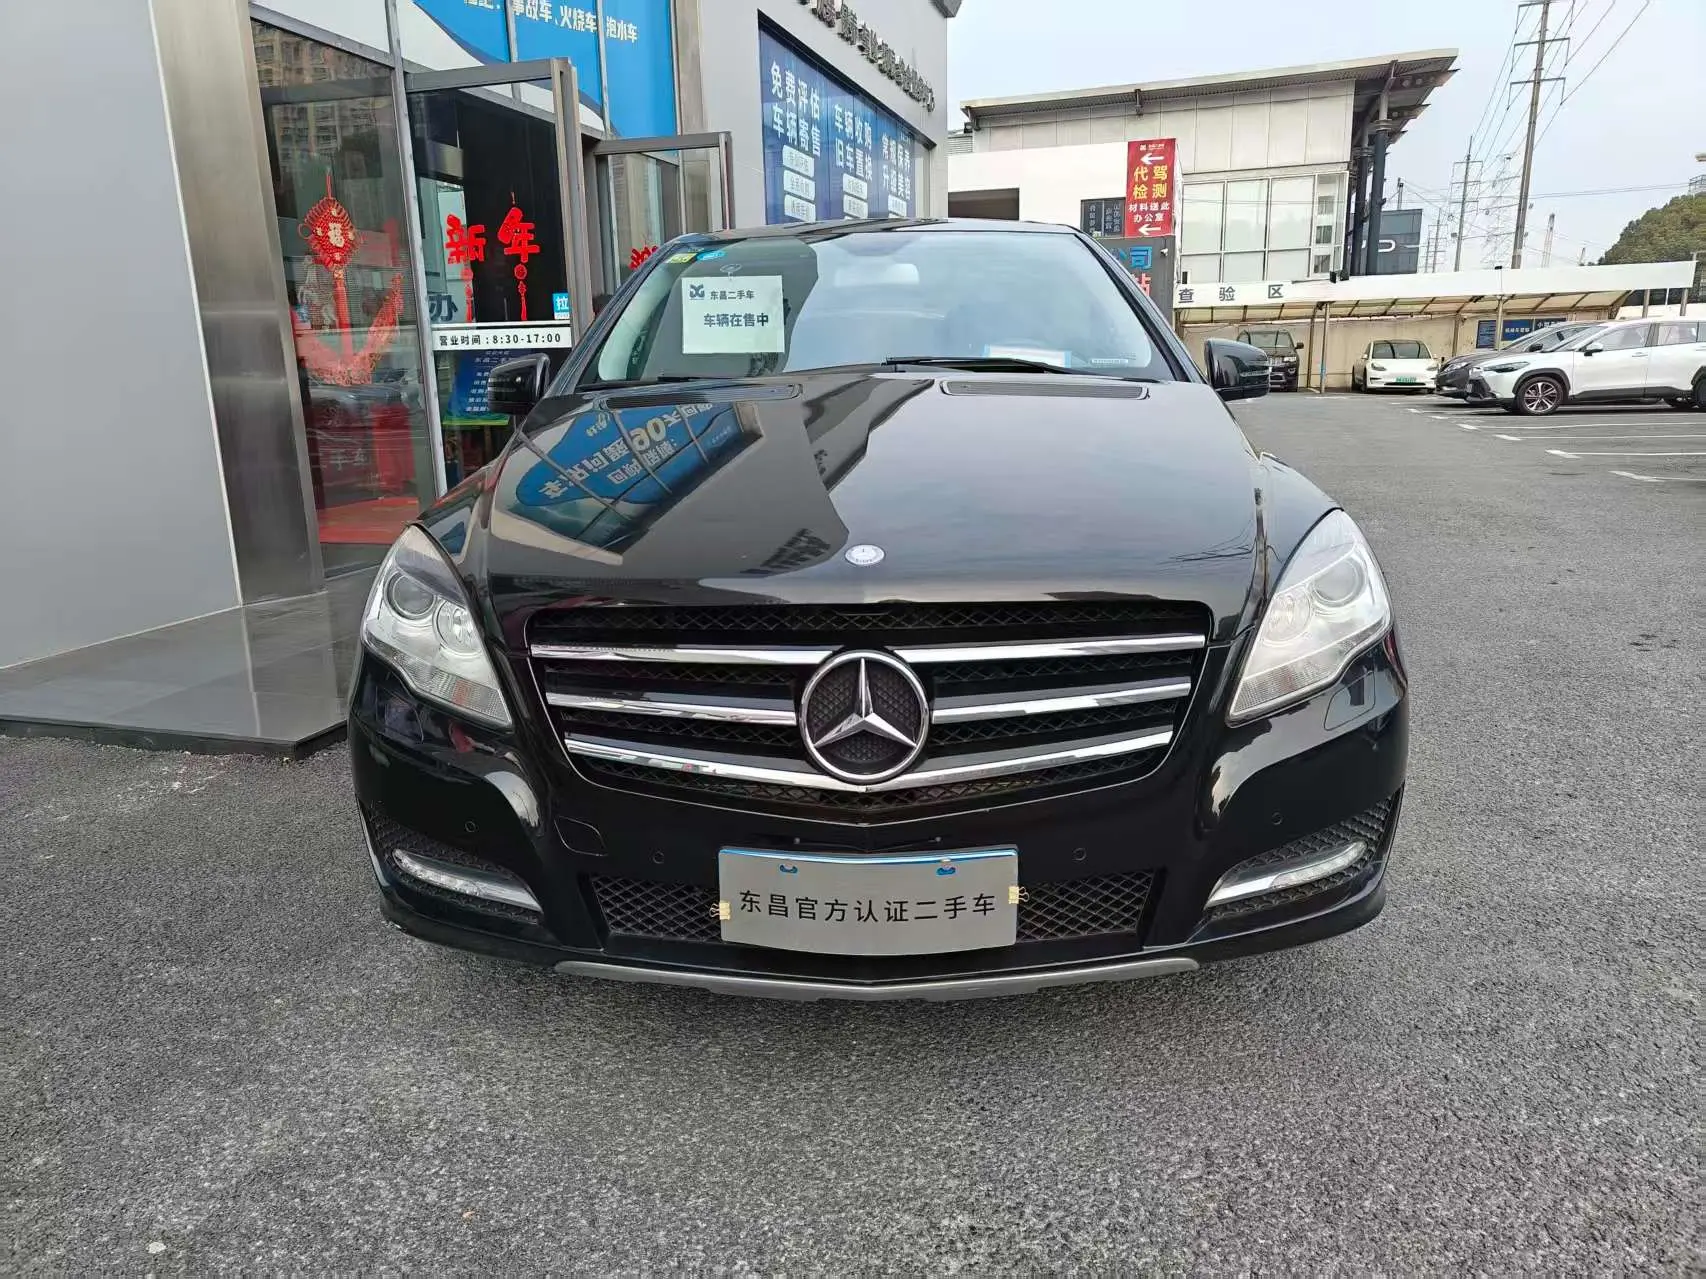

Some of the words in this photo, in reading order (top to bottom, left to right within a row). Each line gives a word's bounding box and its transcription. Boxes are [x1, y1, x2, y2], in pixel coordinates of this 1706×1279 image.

[771, 60, 820, 120] 免费评估
[772, 103, 820, 157] 车辆寄售
[834, 103, 871, 150] 车辆收购
[835, 137, 872, 181] 旧车置换
[1133, 165, 1168, 182] 代驾
[1132, 183, 1168, 200] 检测
[1133, 213, 1164, 223] 办公室
[446, 207, 540, 264] 新年
[556, 294, 569, 311] 拉
[710, 289, 754, 300] 东昌二手车
[1178, 284, 1284, 303] 查验区
[703, 312, 769, 327] 车辆在售中
[739, 889, 996, 923] 东昌官方认证二手车
